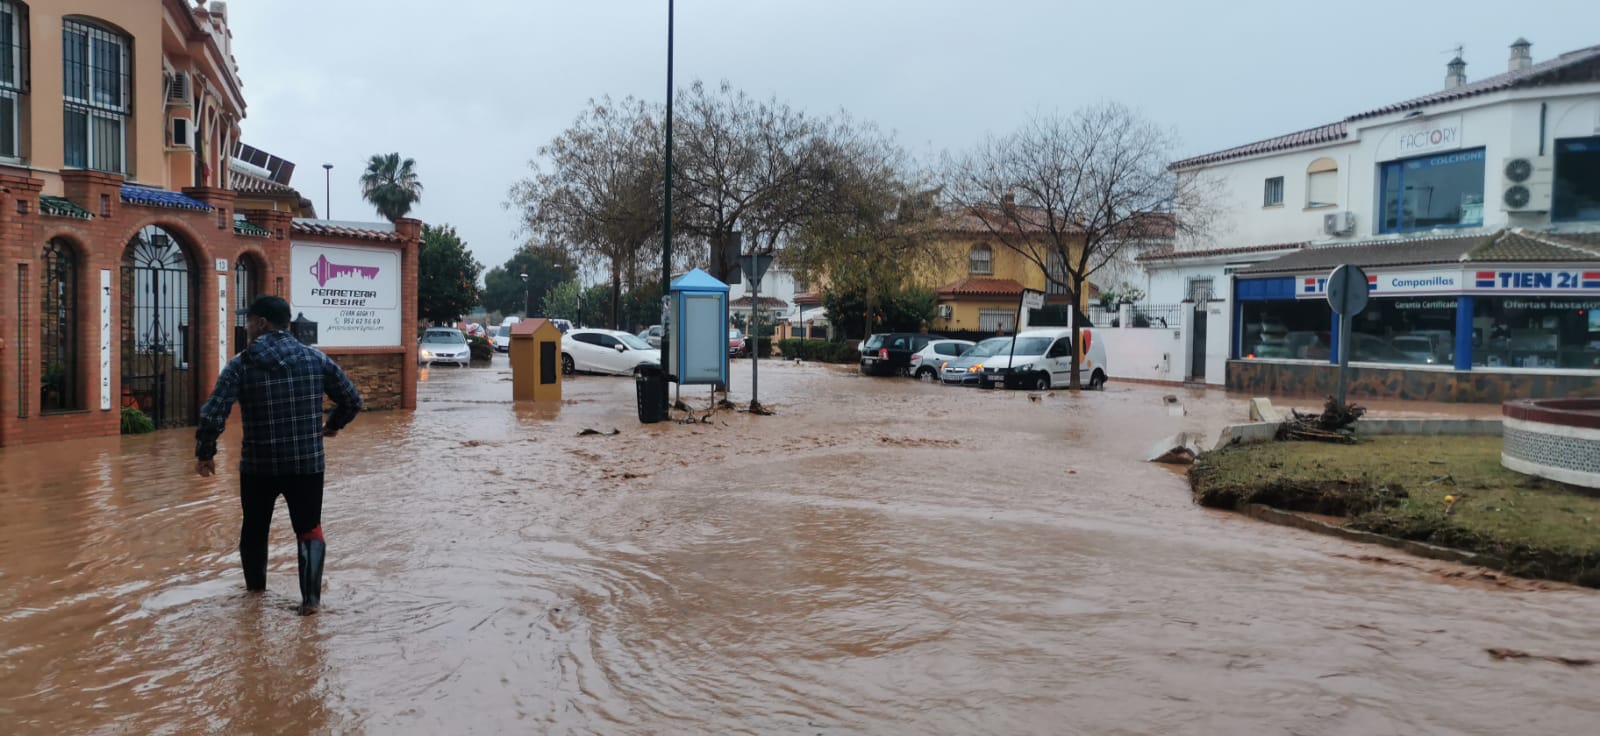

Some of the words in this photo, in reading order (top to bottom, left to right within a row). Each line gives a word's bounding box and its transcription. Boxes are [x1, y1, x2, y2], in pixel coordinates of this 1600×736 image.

[1400, 127, 1457, 152] FACTORY
[1391, 276, 1454, 289] Campanillas
[1499, 272, 1552, 289] TIEN
[1557, 271, 1578, 289] 21
[1503, 300, 1547, 309] Ofertas
